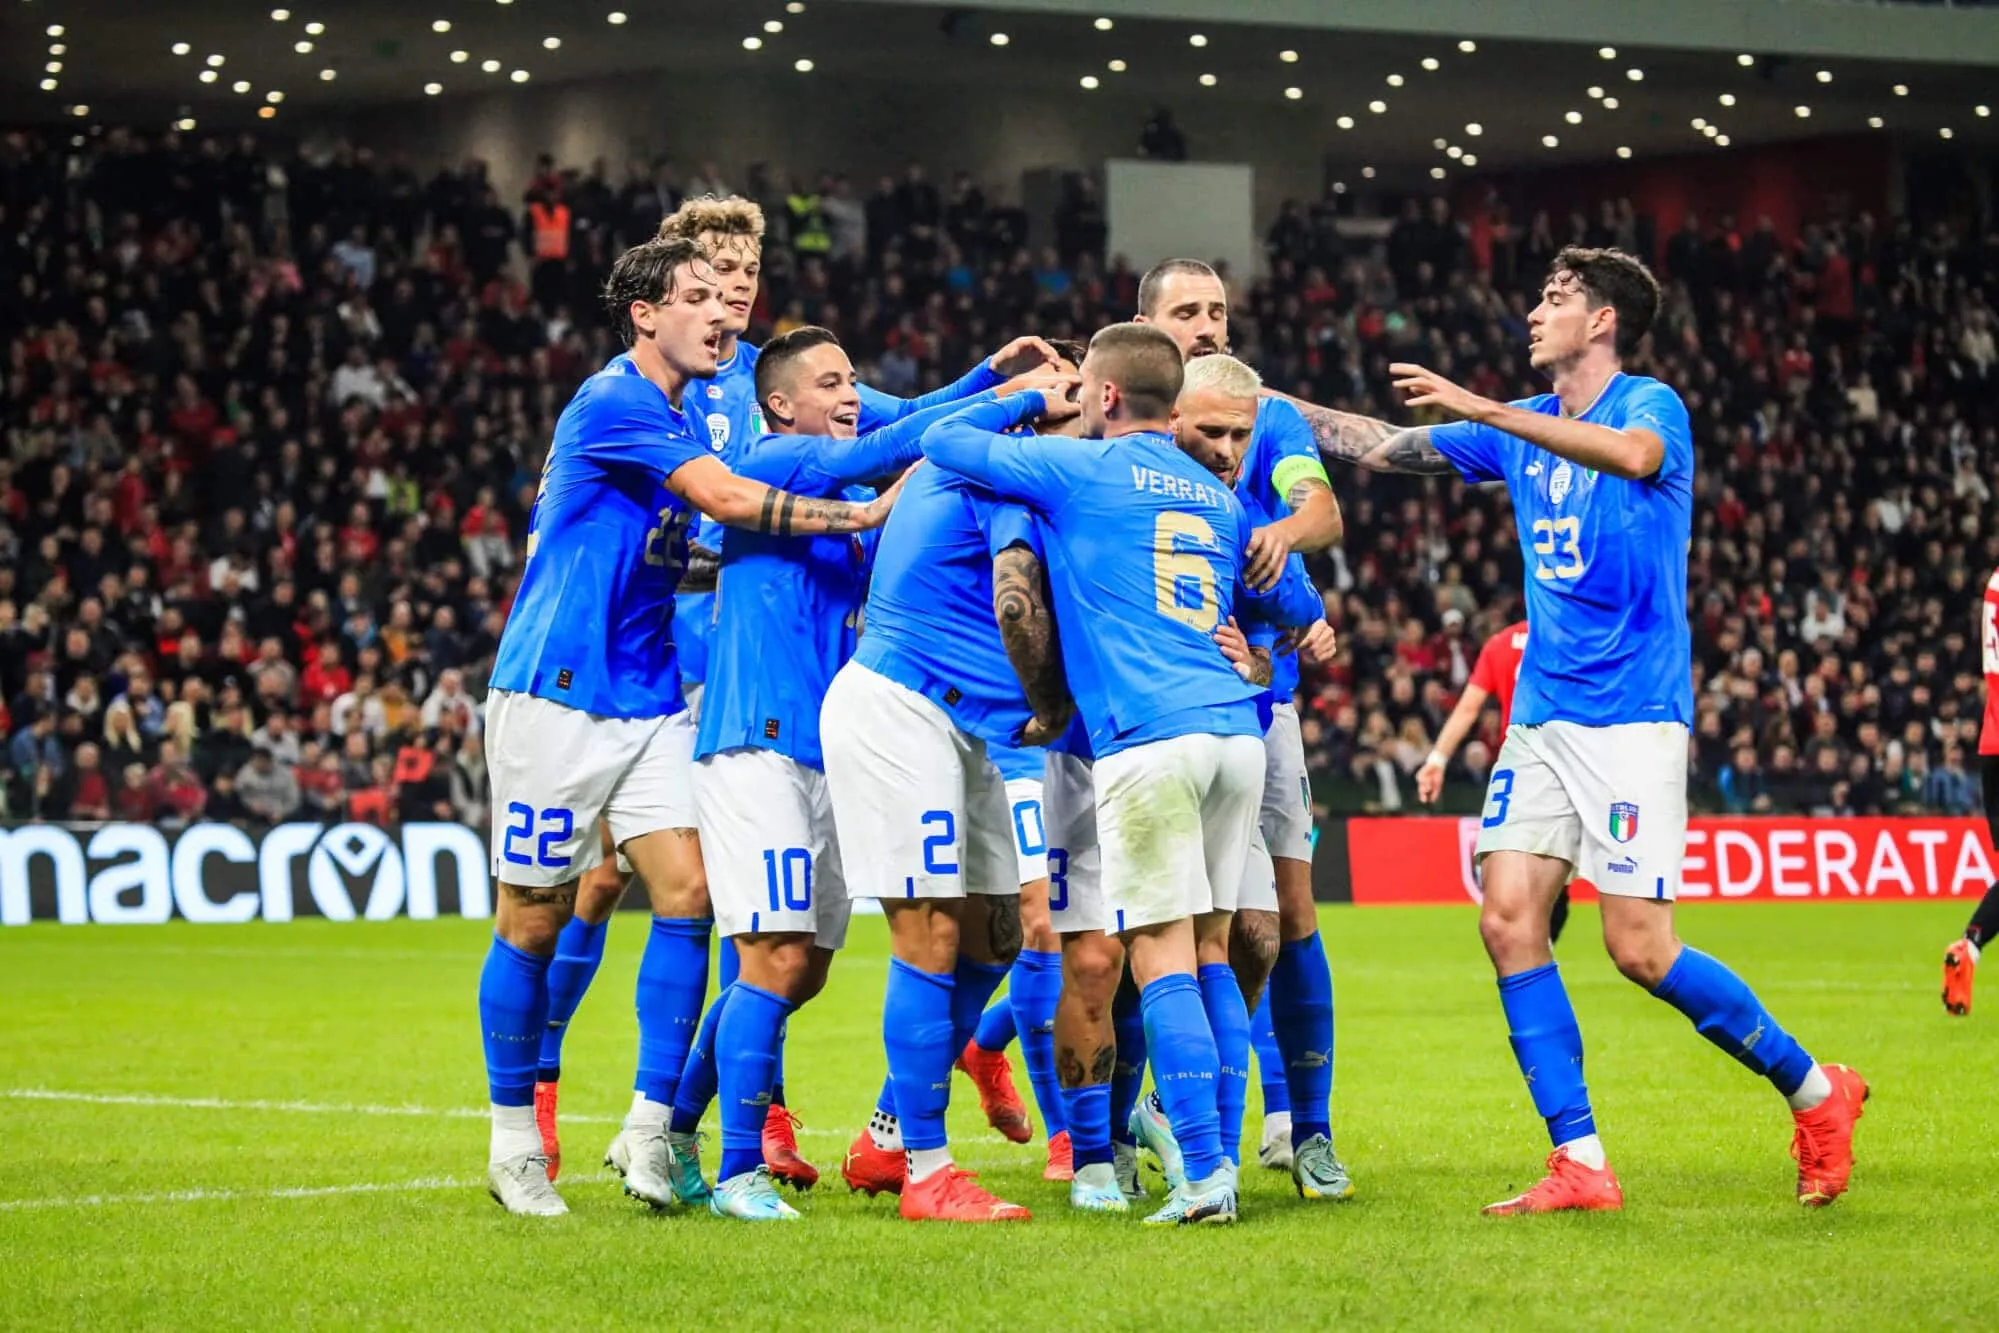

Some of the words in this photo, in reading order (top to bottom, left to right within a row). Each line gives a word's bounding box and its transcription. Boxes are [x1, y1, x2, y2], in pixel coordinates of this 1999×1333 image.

[1131, 464, 1231, 513] VERRATT
[1154, 509, 1220, 633] 6
[1533, 515, 1584, 580] 23
[1013, 800, 1047, 856] 0
[1482, 768, 1515, 829] 3
[504, 801, 573, 867] 22
[921, 810, 959, 874] 2
[1678, 829, 1996, 897] EDERATA
[763, 847, 812, 912] 10
[1221, 1065, 1249, 1080] ALIA
